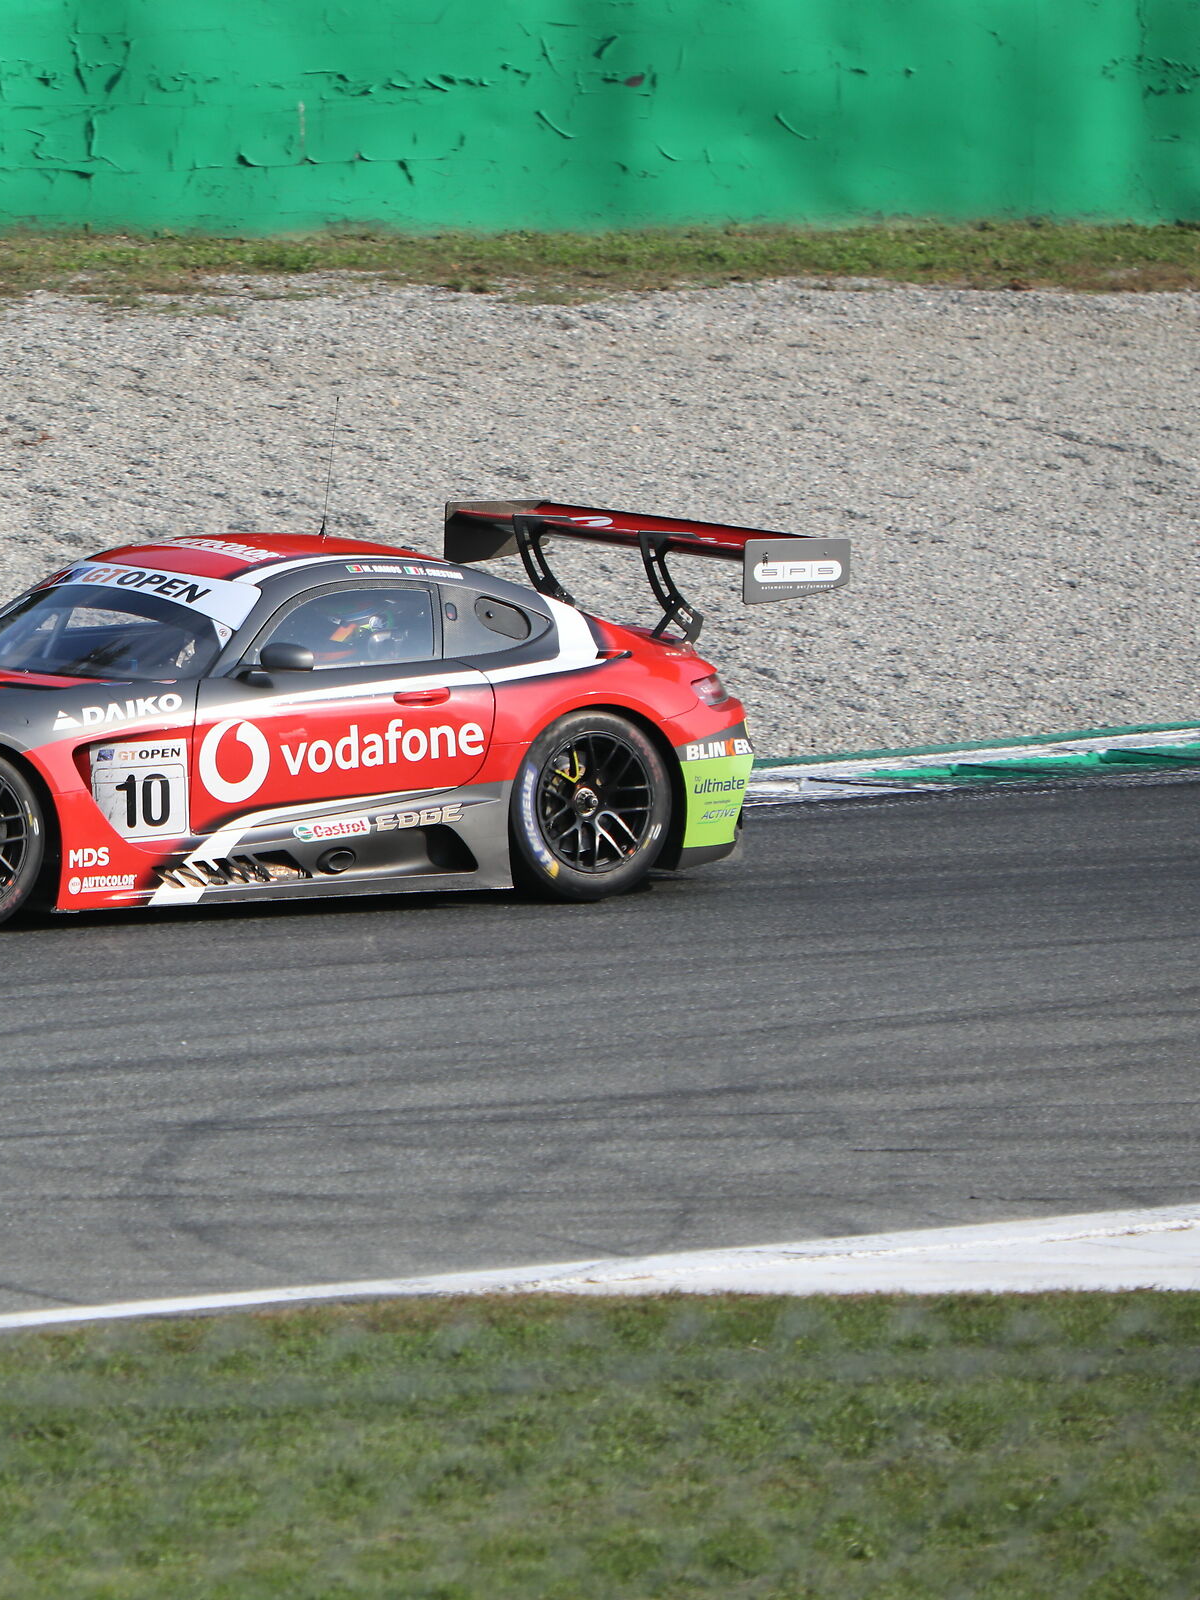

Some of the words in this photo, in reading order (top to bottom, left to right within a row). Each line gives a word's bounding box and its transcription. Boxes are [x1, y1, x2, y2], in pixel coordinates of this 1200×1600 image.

[81, 693, 183, 726] DAIKO
[280, 719, 485, 776] vodafone
[686, 737, 753, 761] BLINKER
[694, 776, 745, 794] ultimate
[115, 773, 170, 829] 10
[522, 769, 544, 853] MICHELIN
[375, 802, 464, 832] EDGE
[701, 807, 738, 820] ACTIVE
[313, 819, 368, 838] Castrol
[68, 846, 110, 869] MDS
[82, 874, 136, 888] AUTOCOLOR
